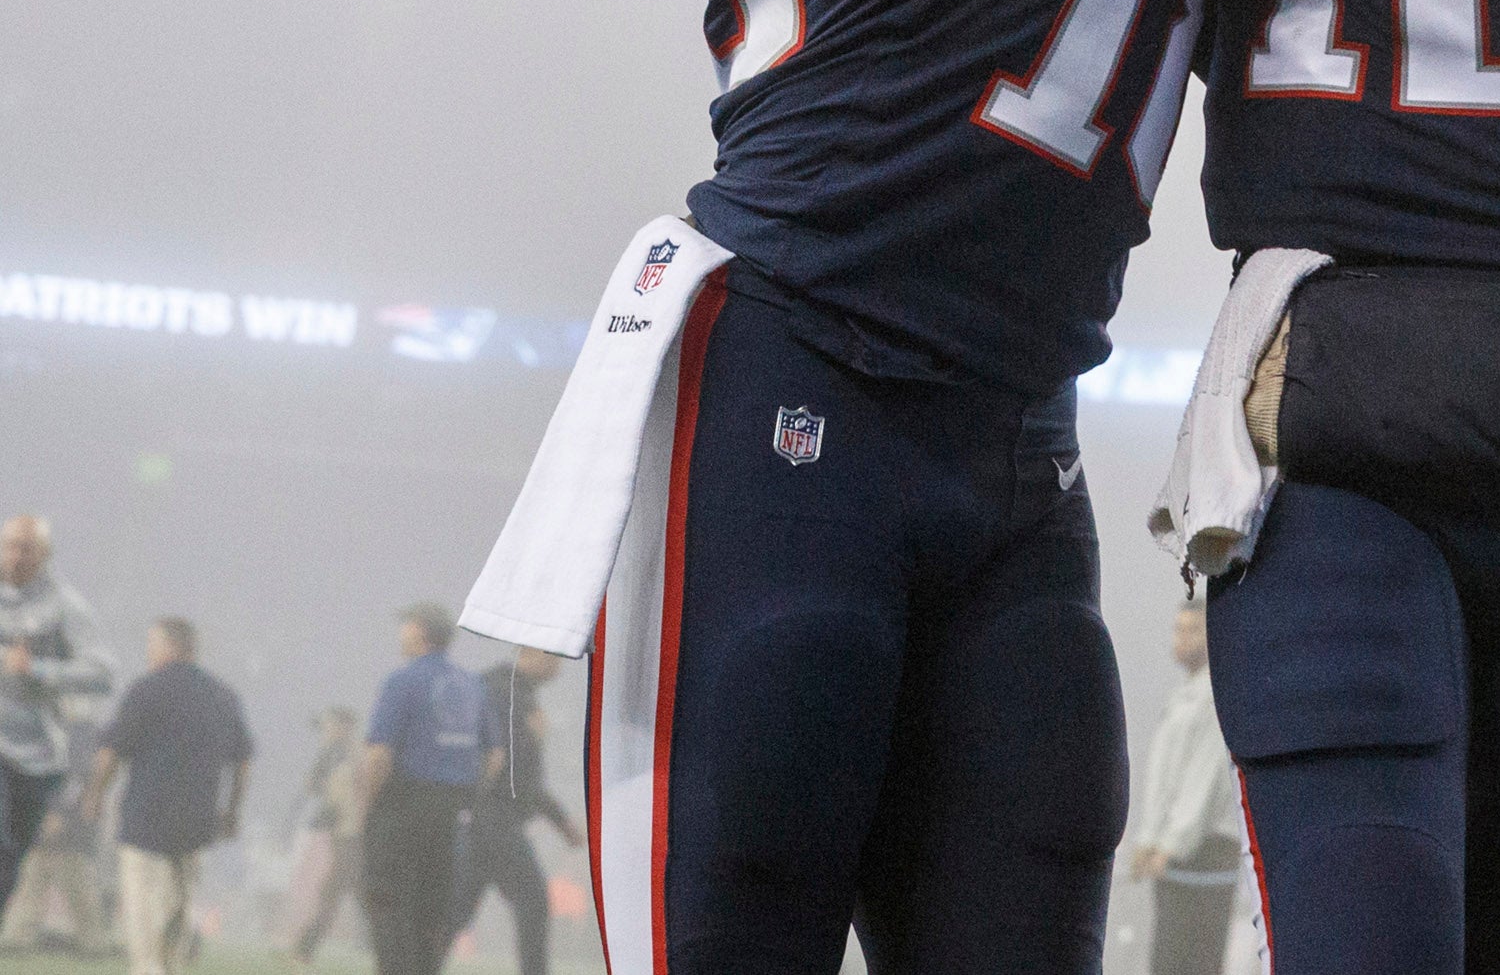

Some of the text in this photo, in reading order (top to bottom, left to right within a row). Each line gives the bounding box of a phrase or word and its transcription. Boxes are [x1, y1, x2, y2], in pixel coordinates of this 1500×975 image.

[637, 264, 667, 290] NFL
[0, 274, 357, 347] ATRIOTS WIN
[608, 315, 652, 333] Wilson
[781, 430, 812, 456] NFL
